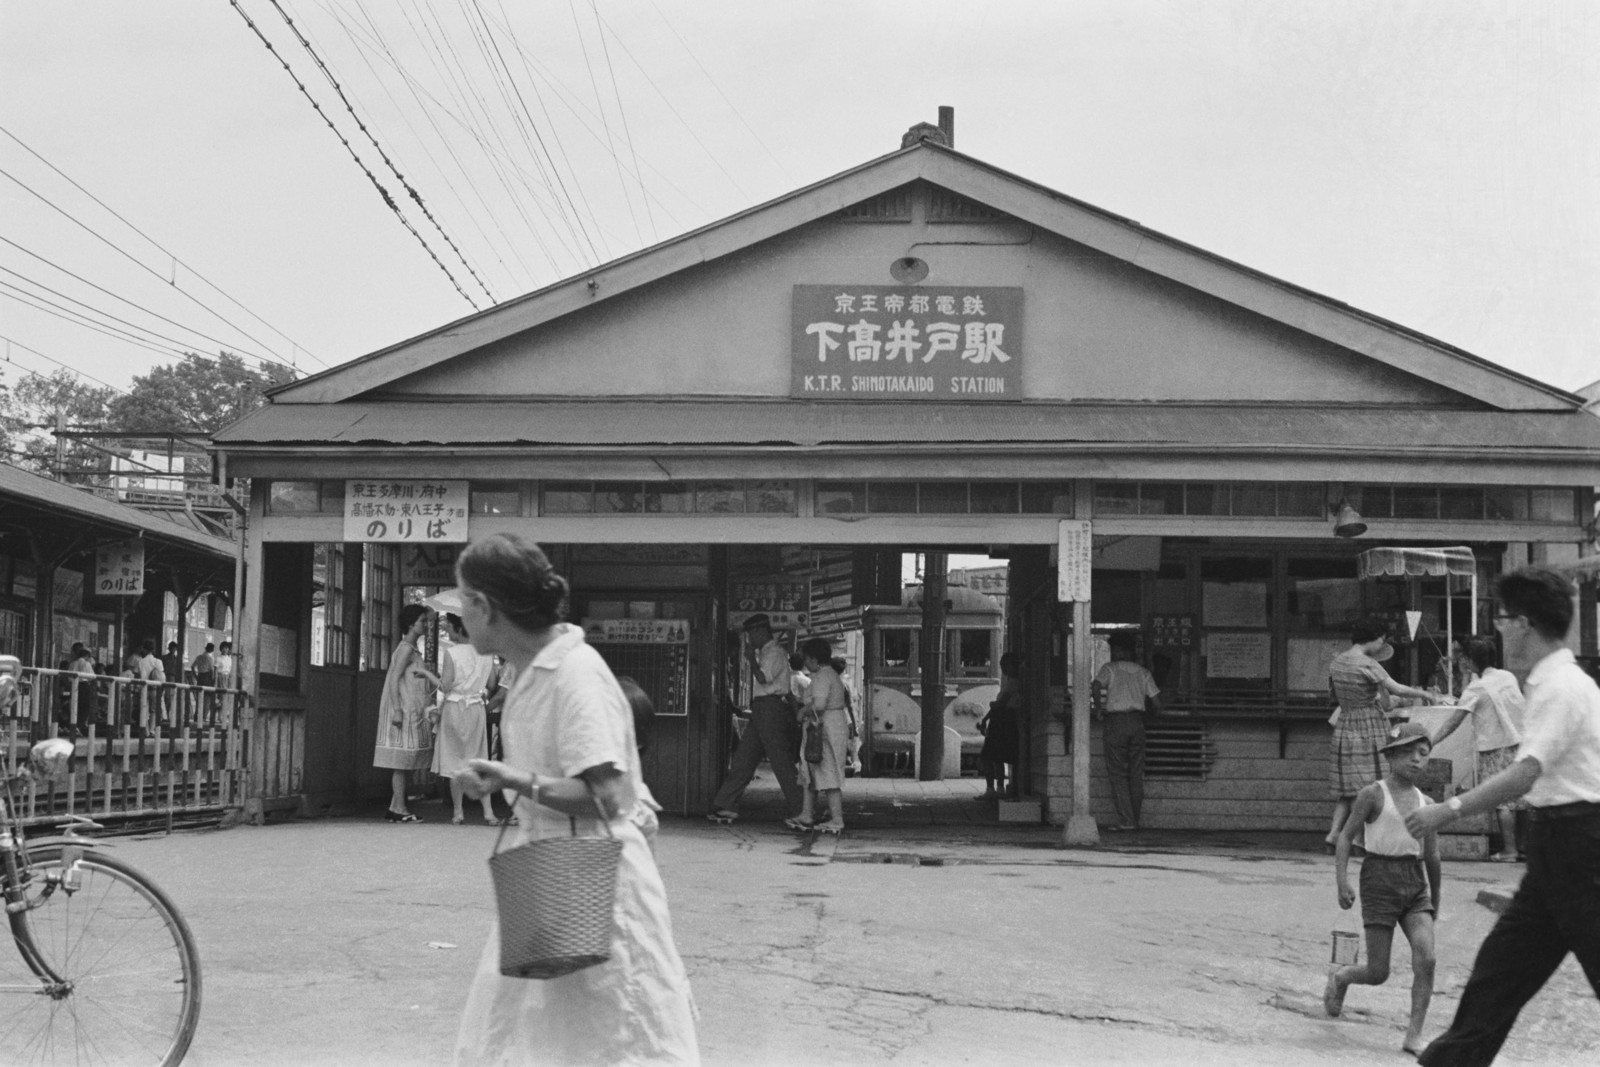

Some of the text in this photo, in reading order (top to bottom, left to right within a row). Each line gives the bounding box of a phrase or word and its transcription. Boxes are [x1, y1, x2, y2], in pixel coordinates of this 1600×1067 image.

[834, 292, 987, 316] 京王帝都電鉄
[805, 318, 1012, 364] 下高井戸駅
[804, 375, 1005, 394] K.T.R. SHIMOTAKAIDO STATION
[366, 518, 451, 539] のりば
[101, 577, 140, 592] のりば
[739, 599, 799, 611] のりば
